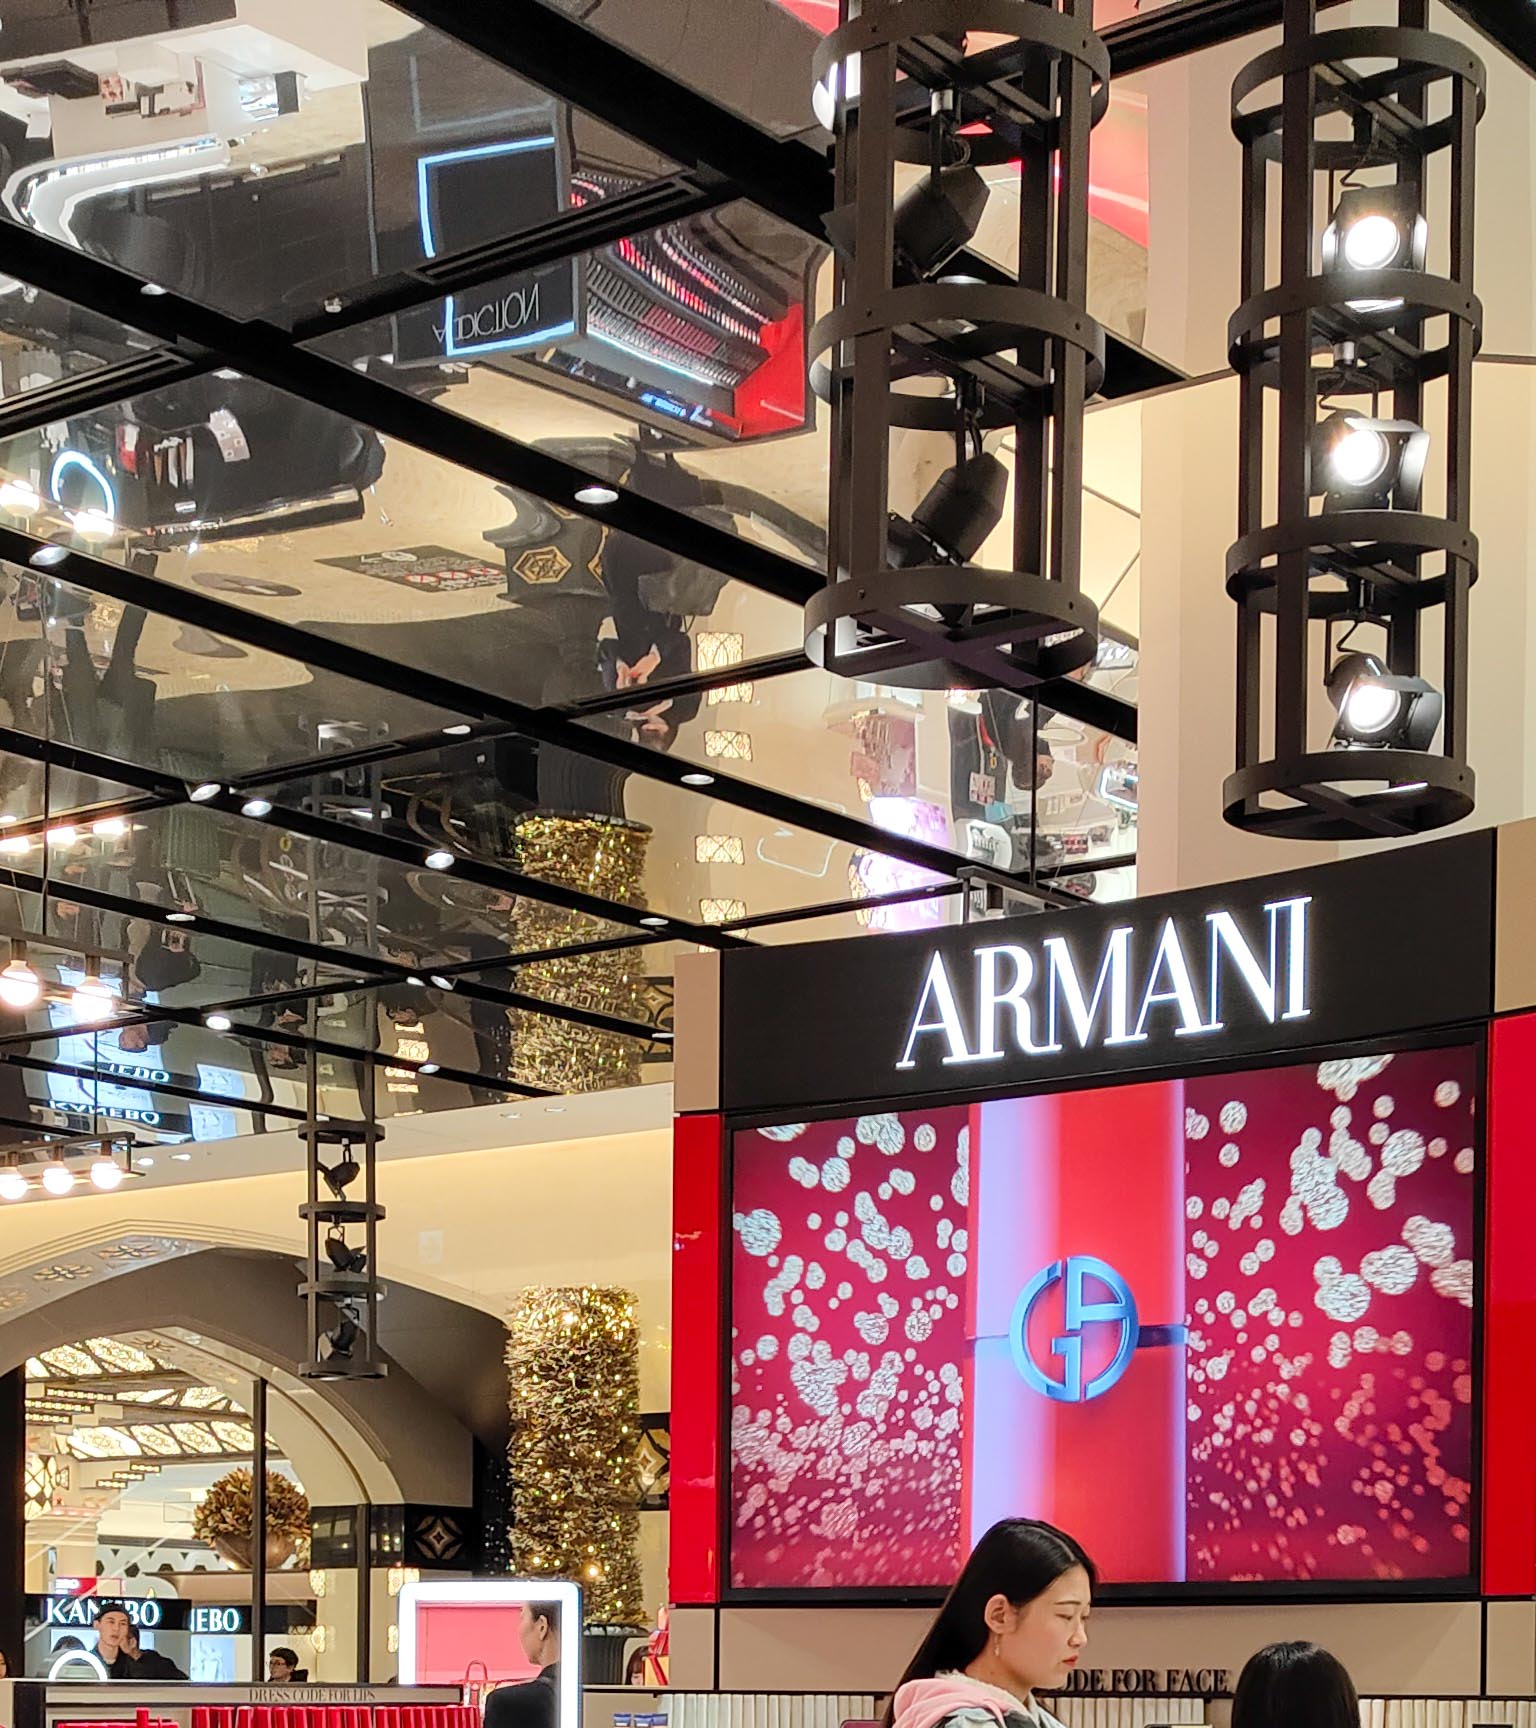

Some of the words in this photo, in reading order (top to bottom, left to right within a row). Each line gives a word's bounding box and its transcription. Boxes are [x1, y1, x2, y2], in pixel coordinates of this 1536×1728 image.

[896, 896, 1313, 1071] ARMANI
[1111, 1668, 1157, 1692] FOR
[1166, 1668, 1230, 1692] FACE
[249, 1688, 290, 1702] DRESS
[293, 1688, 325, 1702] CODE
[329, 1688, 350, 1702] FOR
[353, 1688, 376, 1702] LIPS
